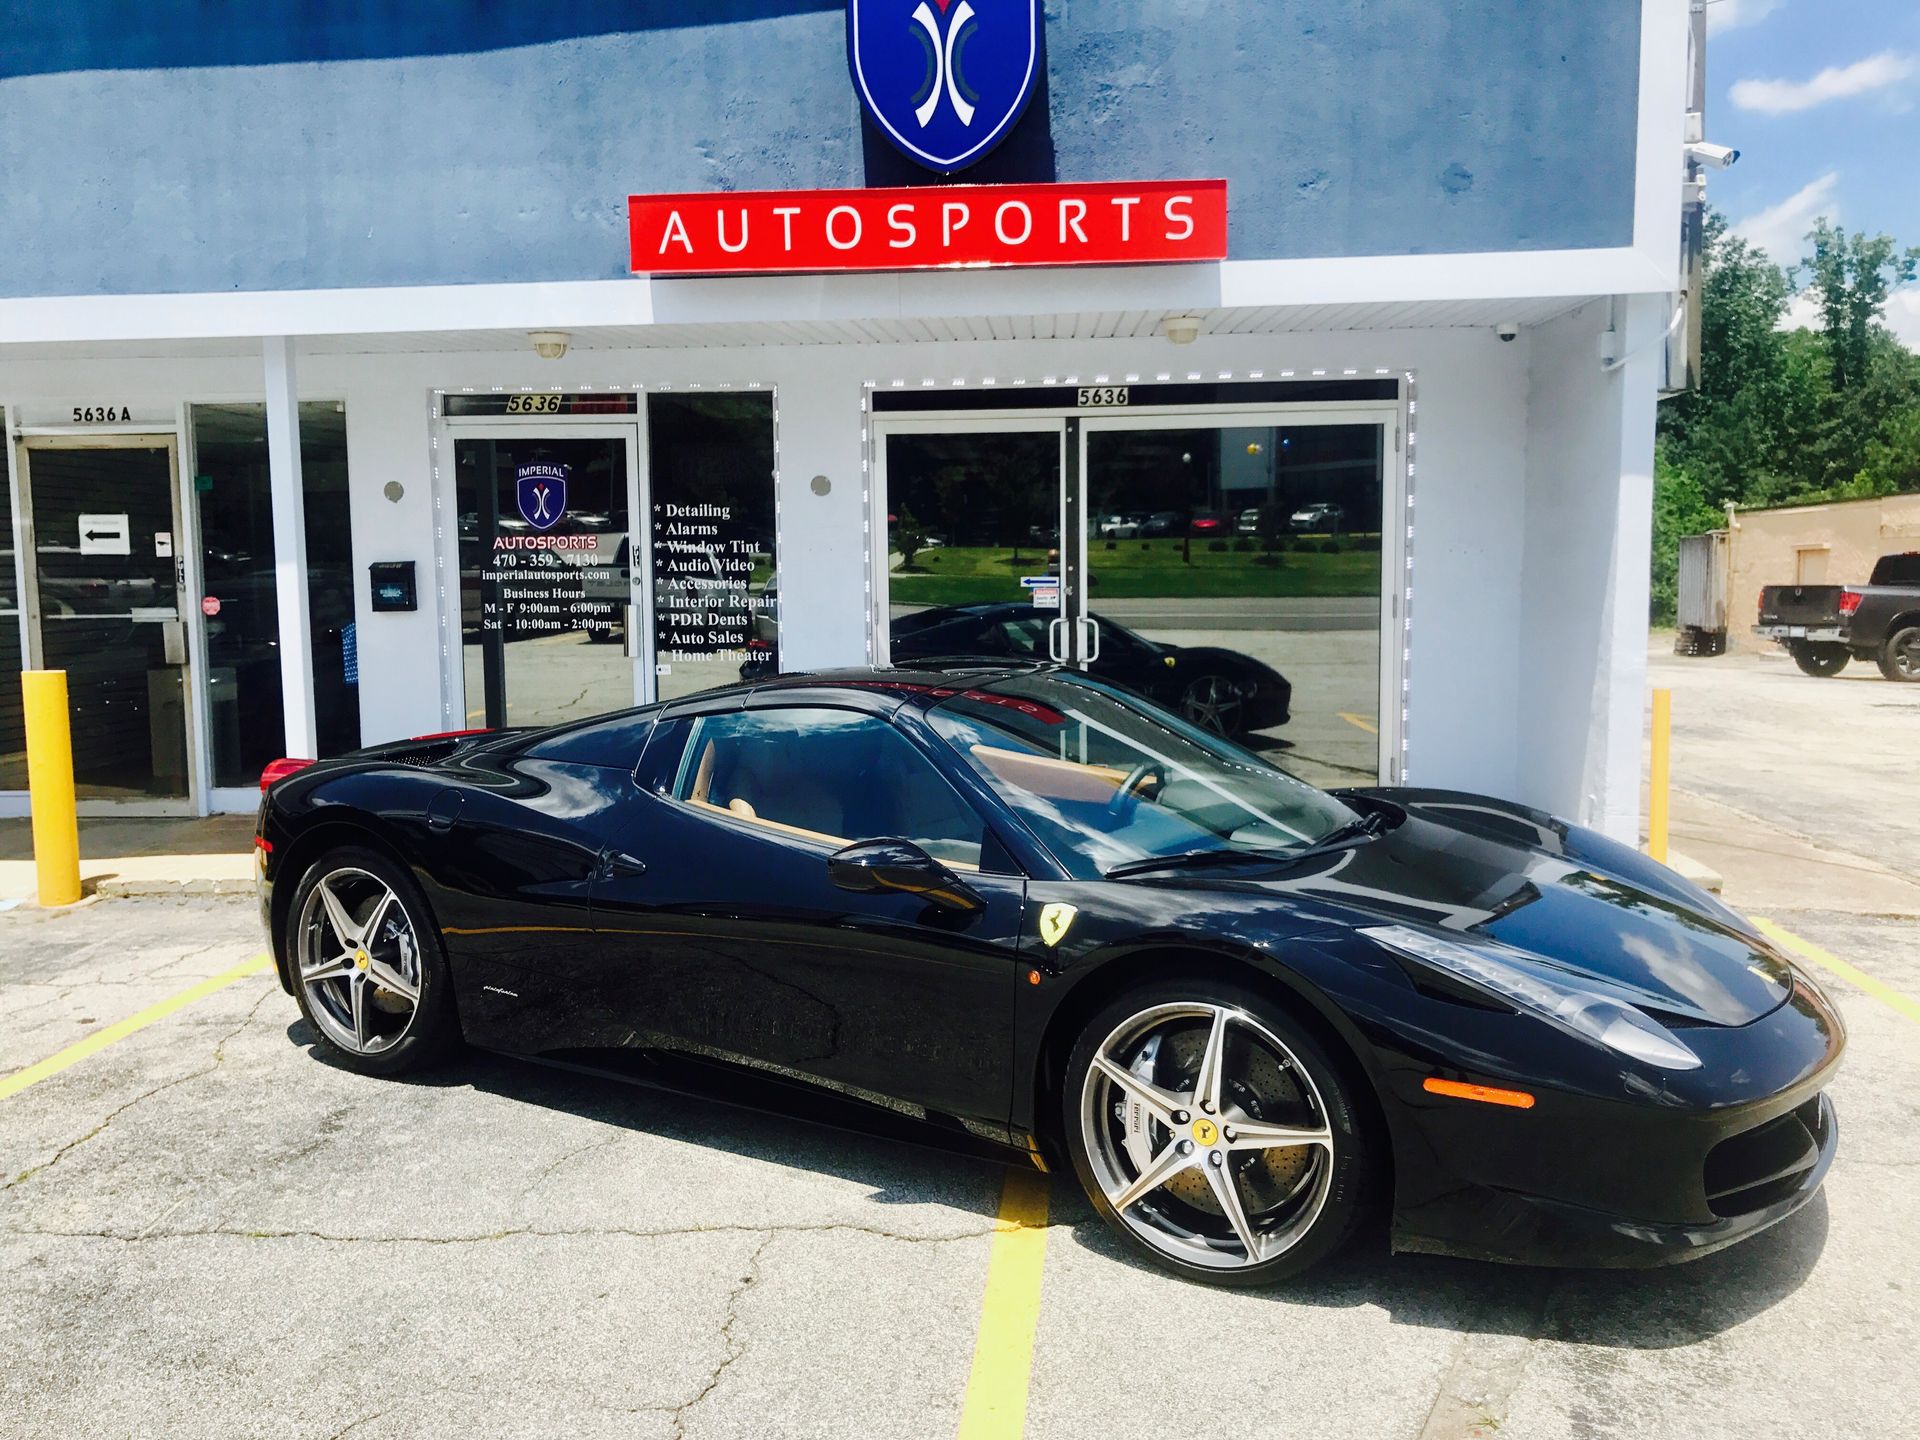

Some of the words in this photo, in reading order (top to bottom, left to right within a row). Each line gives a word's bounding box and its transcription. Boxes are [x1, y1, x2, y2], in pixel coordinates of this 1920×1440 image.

[659, 195, 1193, 255] AUTOSPORTS
[1080, 388, 1126, 405] 5636
[509, 396, 560, 411] 5636
[518, 465, 564, 477] IMPERIAL
[666, 503, 730, 520] Detailing
[666, 522, 718, 535] Alarms
[493, 535, 597, 550] AUTOSPORTS
[667, 540, 726, 553] Window
[730, 540, 760, 553] Tint
[492, 554, 516, 567] 470
[529, 553, 553, 567] 359
[567, 553, 598, 567] 7130
[667, 559, 710, 572] Audio
[716, 559, 755, 572] Video
[482, 569, 610, 582] imperialautosports.com
[667, 576, 747, 590] Accessories
[503, 588, 549, 599] Business
[552, 588, 586, 599] Hours
[484, 603, 496, 613] M
[507, 603, 514, 613] F
[520, 603, 560, 613] 9:00am
[570, 603, 611, 615] 6:00pm
[669, 595, 724, 608] Interior
[729, 595, 777, 611] Repair
[483, 619, 503, 629] Sat
[515, 619, 561, 629] 10:00am
[571, 619, 612, 631] 2:00pm
[670, 613, 704, 626] PDR
[708, 613, 748, 626] Dents
[670, 631, 704, 644] Auto
[708, 631, 744, 644] Sales
[671, 649, 713, 662] Home
[717, 648, 772, 662] Theater
